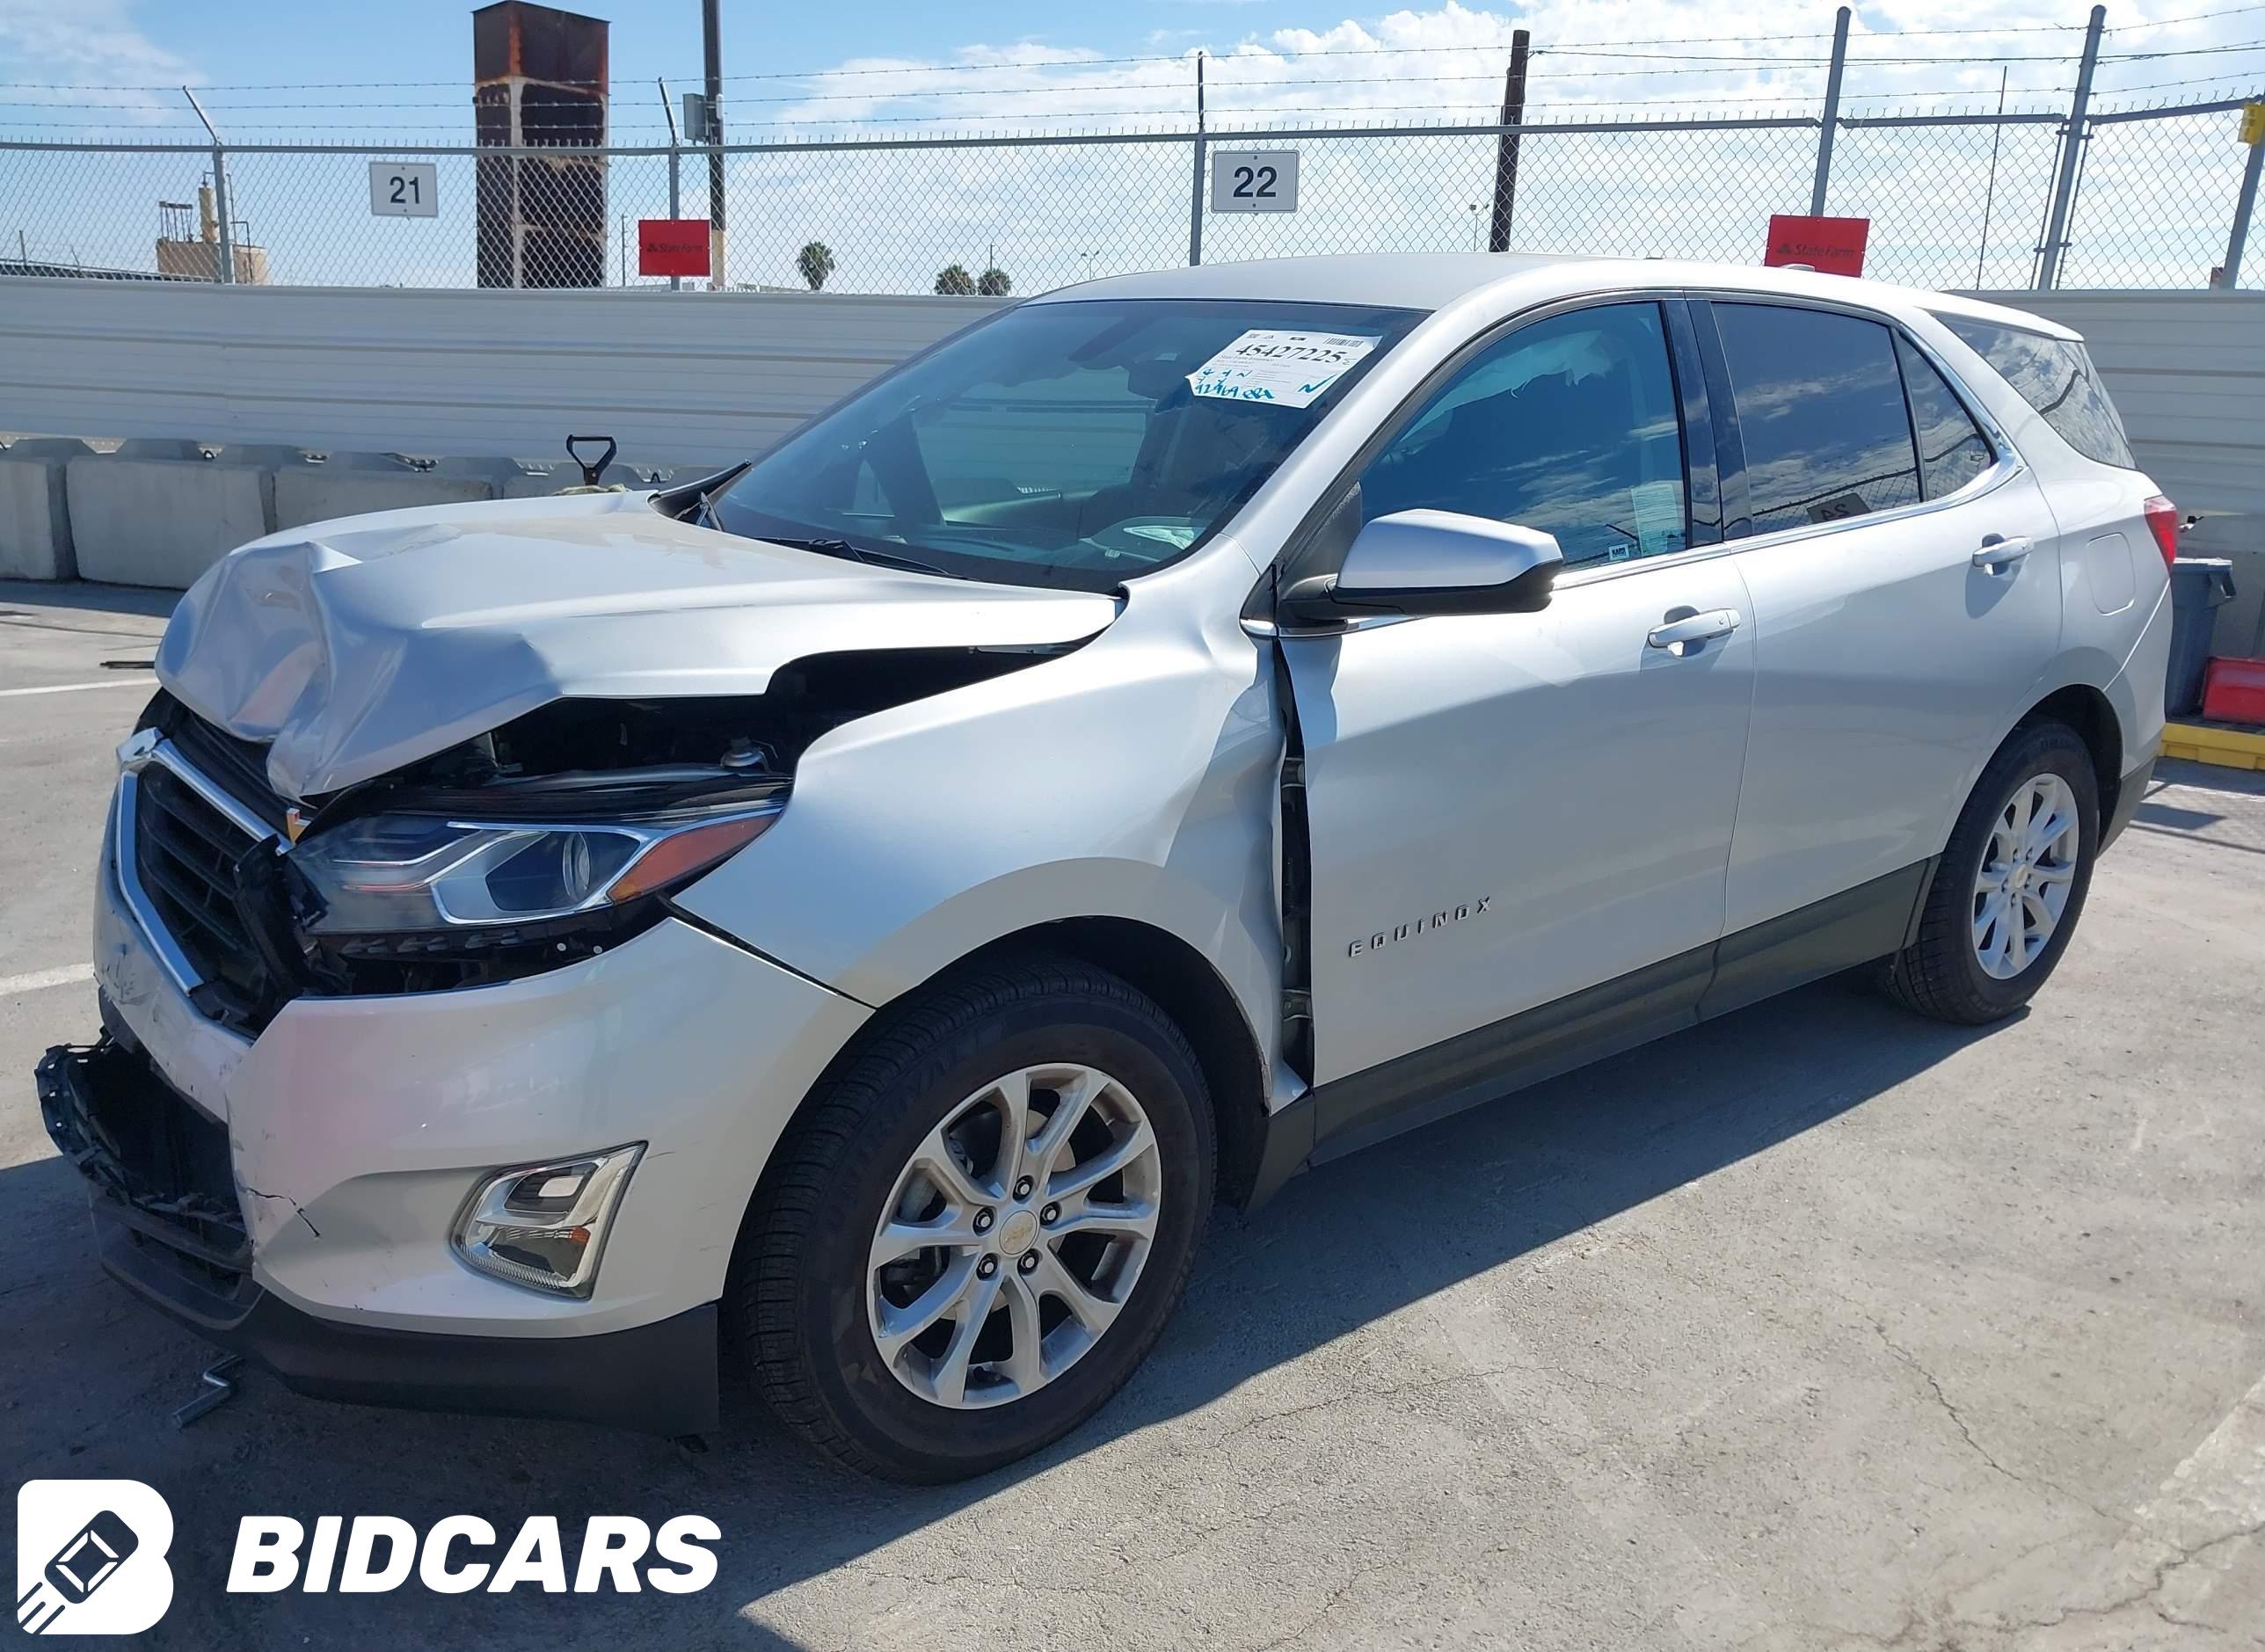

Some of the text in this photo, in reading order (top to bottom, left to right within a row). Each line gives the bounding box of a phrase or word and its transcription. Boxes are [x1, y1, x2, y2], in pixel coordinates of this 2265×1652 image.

[389, 176, 420, 205] 21
[1233, 166, 1278, 198] 22
[1235, 344, 1348, 363] 45427225
[1349, 896, 1492, 957] EQUINOX
